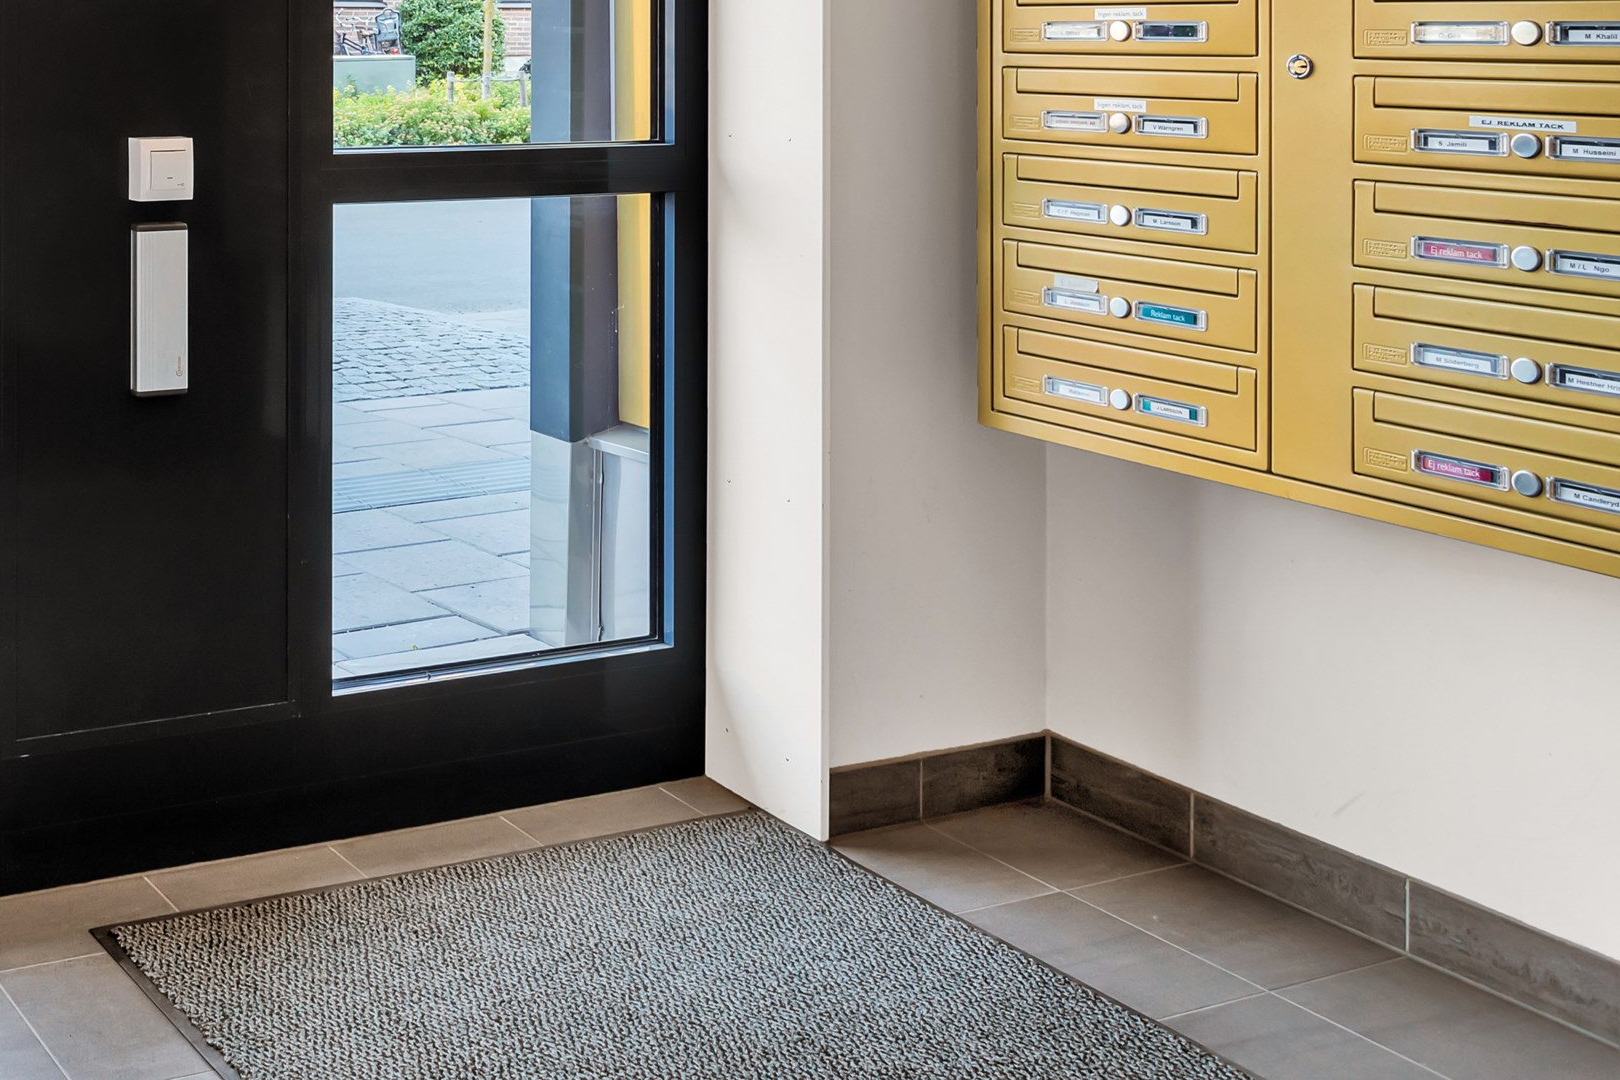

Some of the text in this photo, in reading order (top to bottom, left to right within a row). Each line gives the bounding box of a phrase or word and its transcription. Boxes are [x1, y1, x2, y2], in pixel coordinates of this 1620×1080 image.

[1097, 102, 1111, 110] Ingen
[1497, 120, 1535, 128] REKLAM
[1583, 148, 1616, 156] Husseini
[1430, 246, 1483, 259] Ej reklam tack
[1594, 265, 1610, 273] Ngo
[1151, 309, 1185, 322] Reklam tack
[1443, 357, 1479, 369] Söderberg
[1428, 460, 1480, 478] Ej reklam tack
